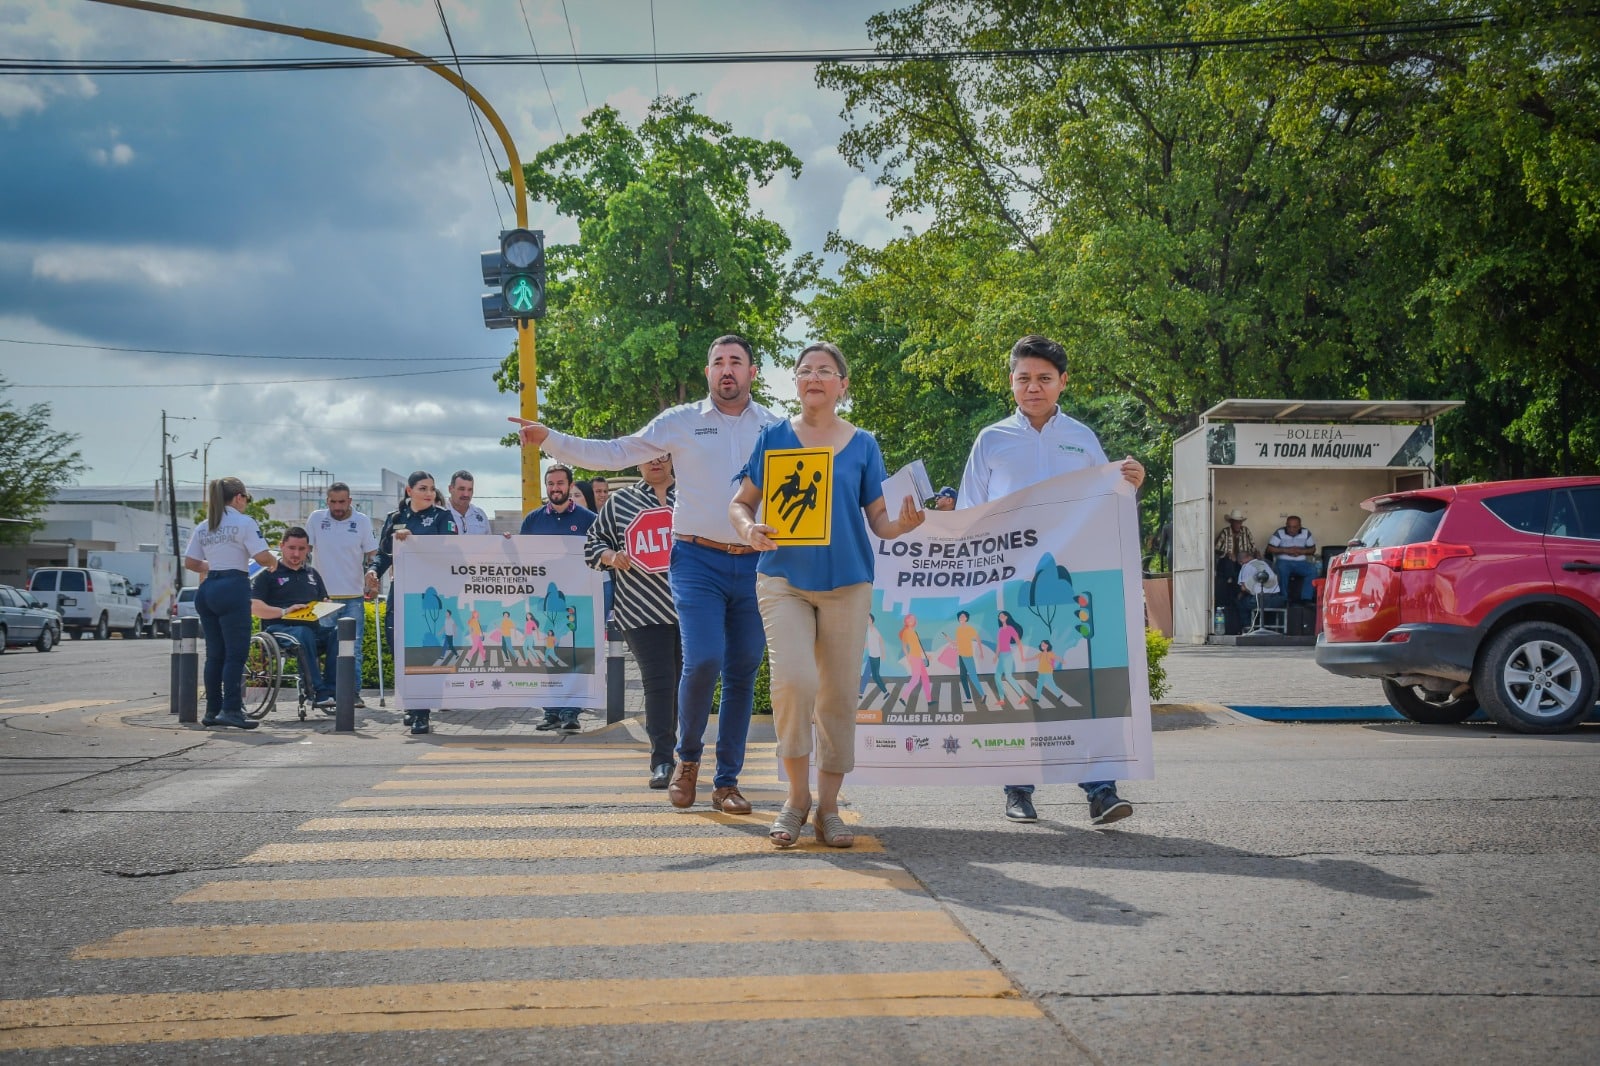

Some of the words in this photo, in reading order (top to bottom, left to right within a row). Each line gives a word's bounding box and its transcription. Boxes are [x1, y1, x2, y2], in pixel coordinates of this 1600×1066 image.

[1286, 427, 1343, 440] BOLERÍA
[1273, 443, 1306, 458] TODA
[635, 527, 670, 554] ALT
[878, 539, 923, 557] LOS
[928, 529, 1039, 559] PEATONES
[912, 559, 964, 570] SIEMPRE
[967, 553, 1005, 568] TIENEN
[451, 565, 477, 575] LOS
[479, 566, 547, 576] PEATONES
[897, 566, 1016, 587] PRIORIDAD
[464, 584, 535, 595] PRIORIDAD
[887, 714, 920, 723] ¡DALES
[922, 714, 933, 723] EL
[984, 738, 1025, 747] IMPLAN
